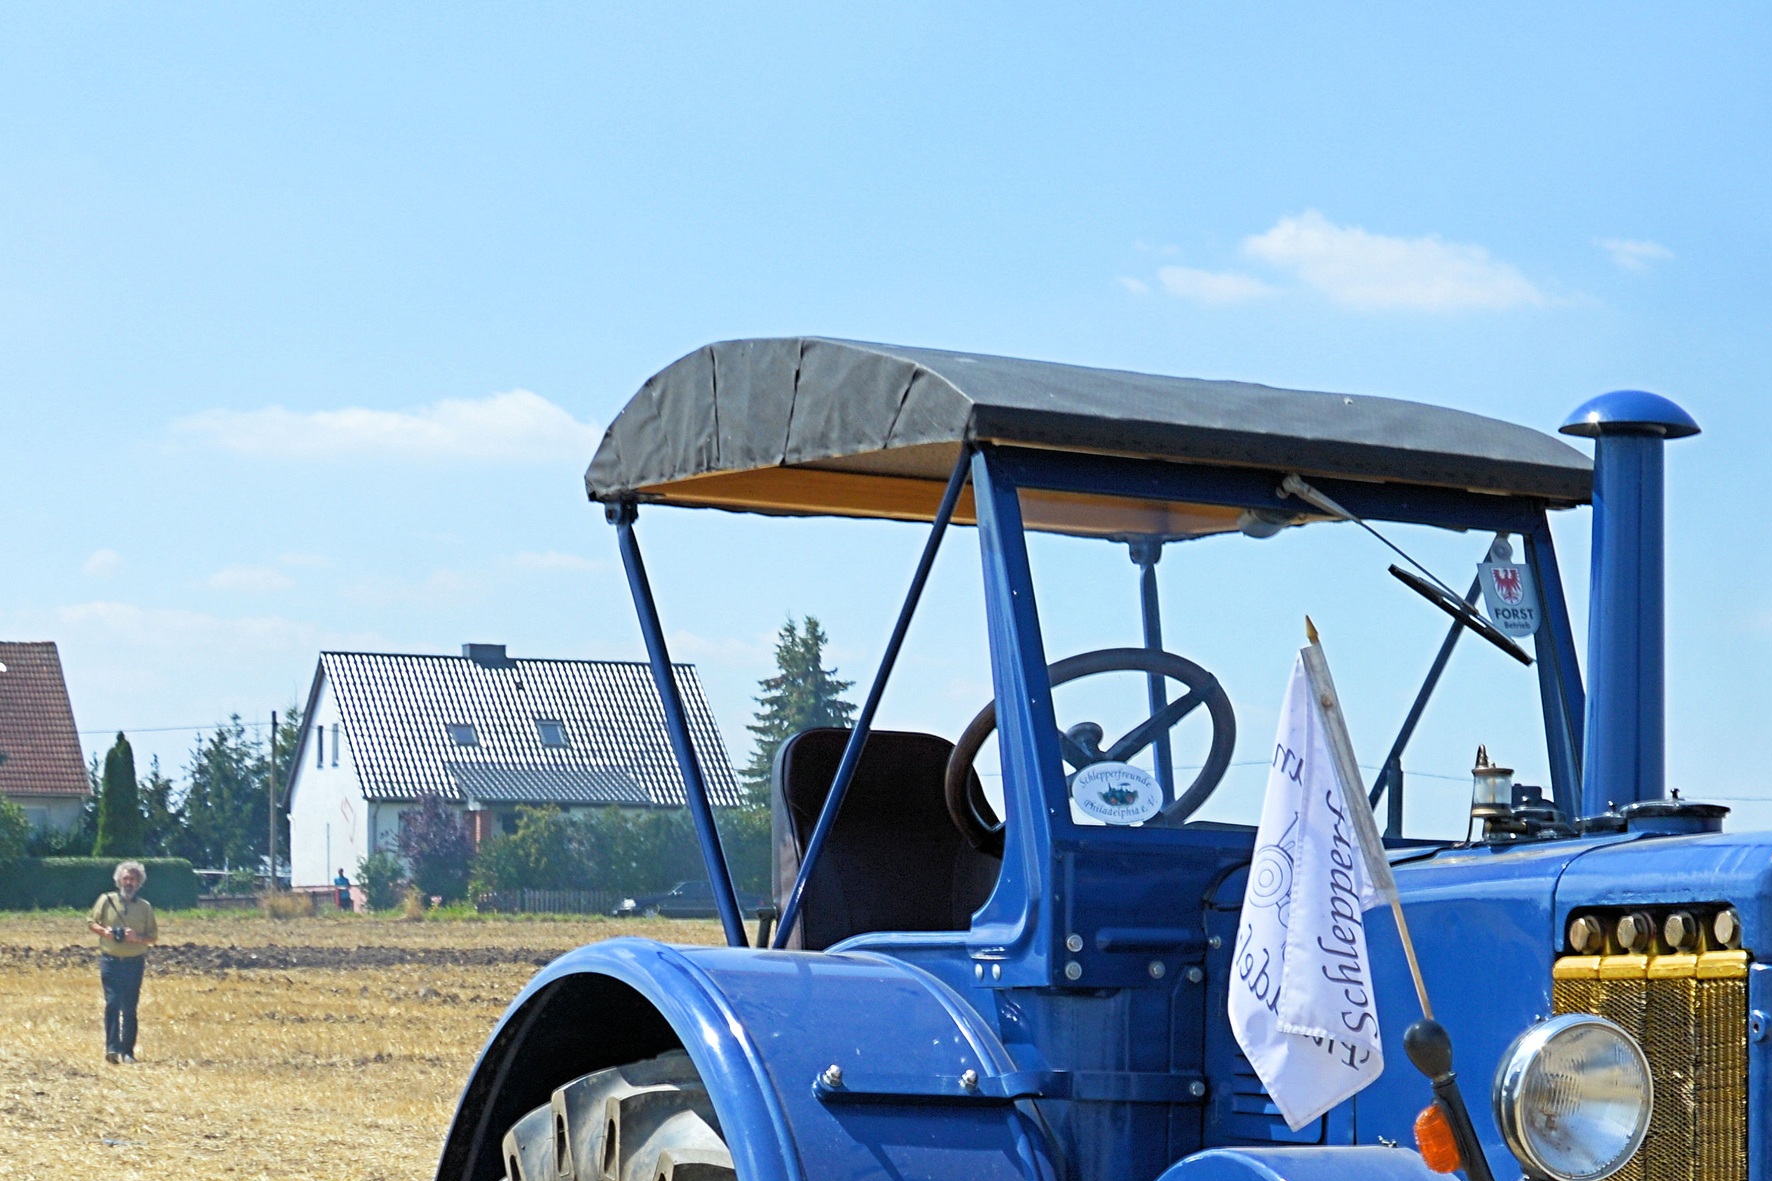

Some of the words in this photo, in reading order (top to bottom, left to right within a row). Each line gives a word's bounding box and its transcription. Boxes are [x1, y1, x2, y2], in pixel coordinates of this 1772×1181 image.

[1494, 608, 1534, 620] FORST
[1504, 621, 1531, 630] Betrieb
[1079, 769, 1152, 789] Schlepperfreunde
[1084, 799, 1140, 819] Philadelphia
